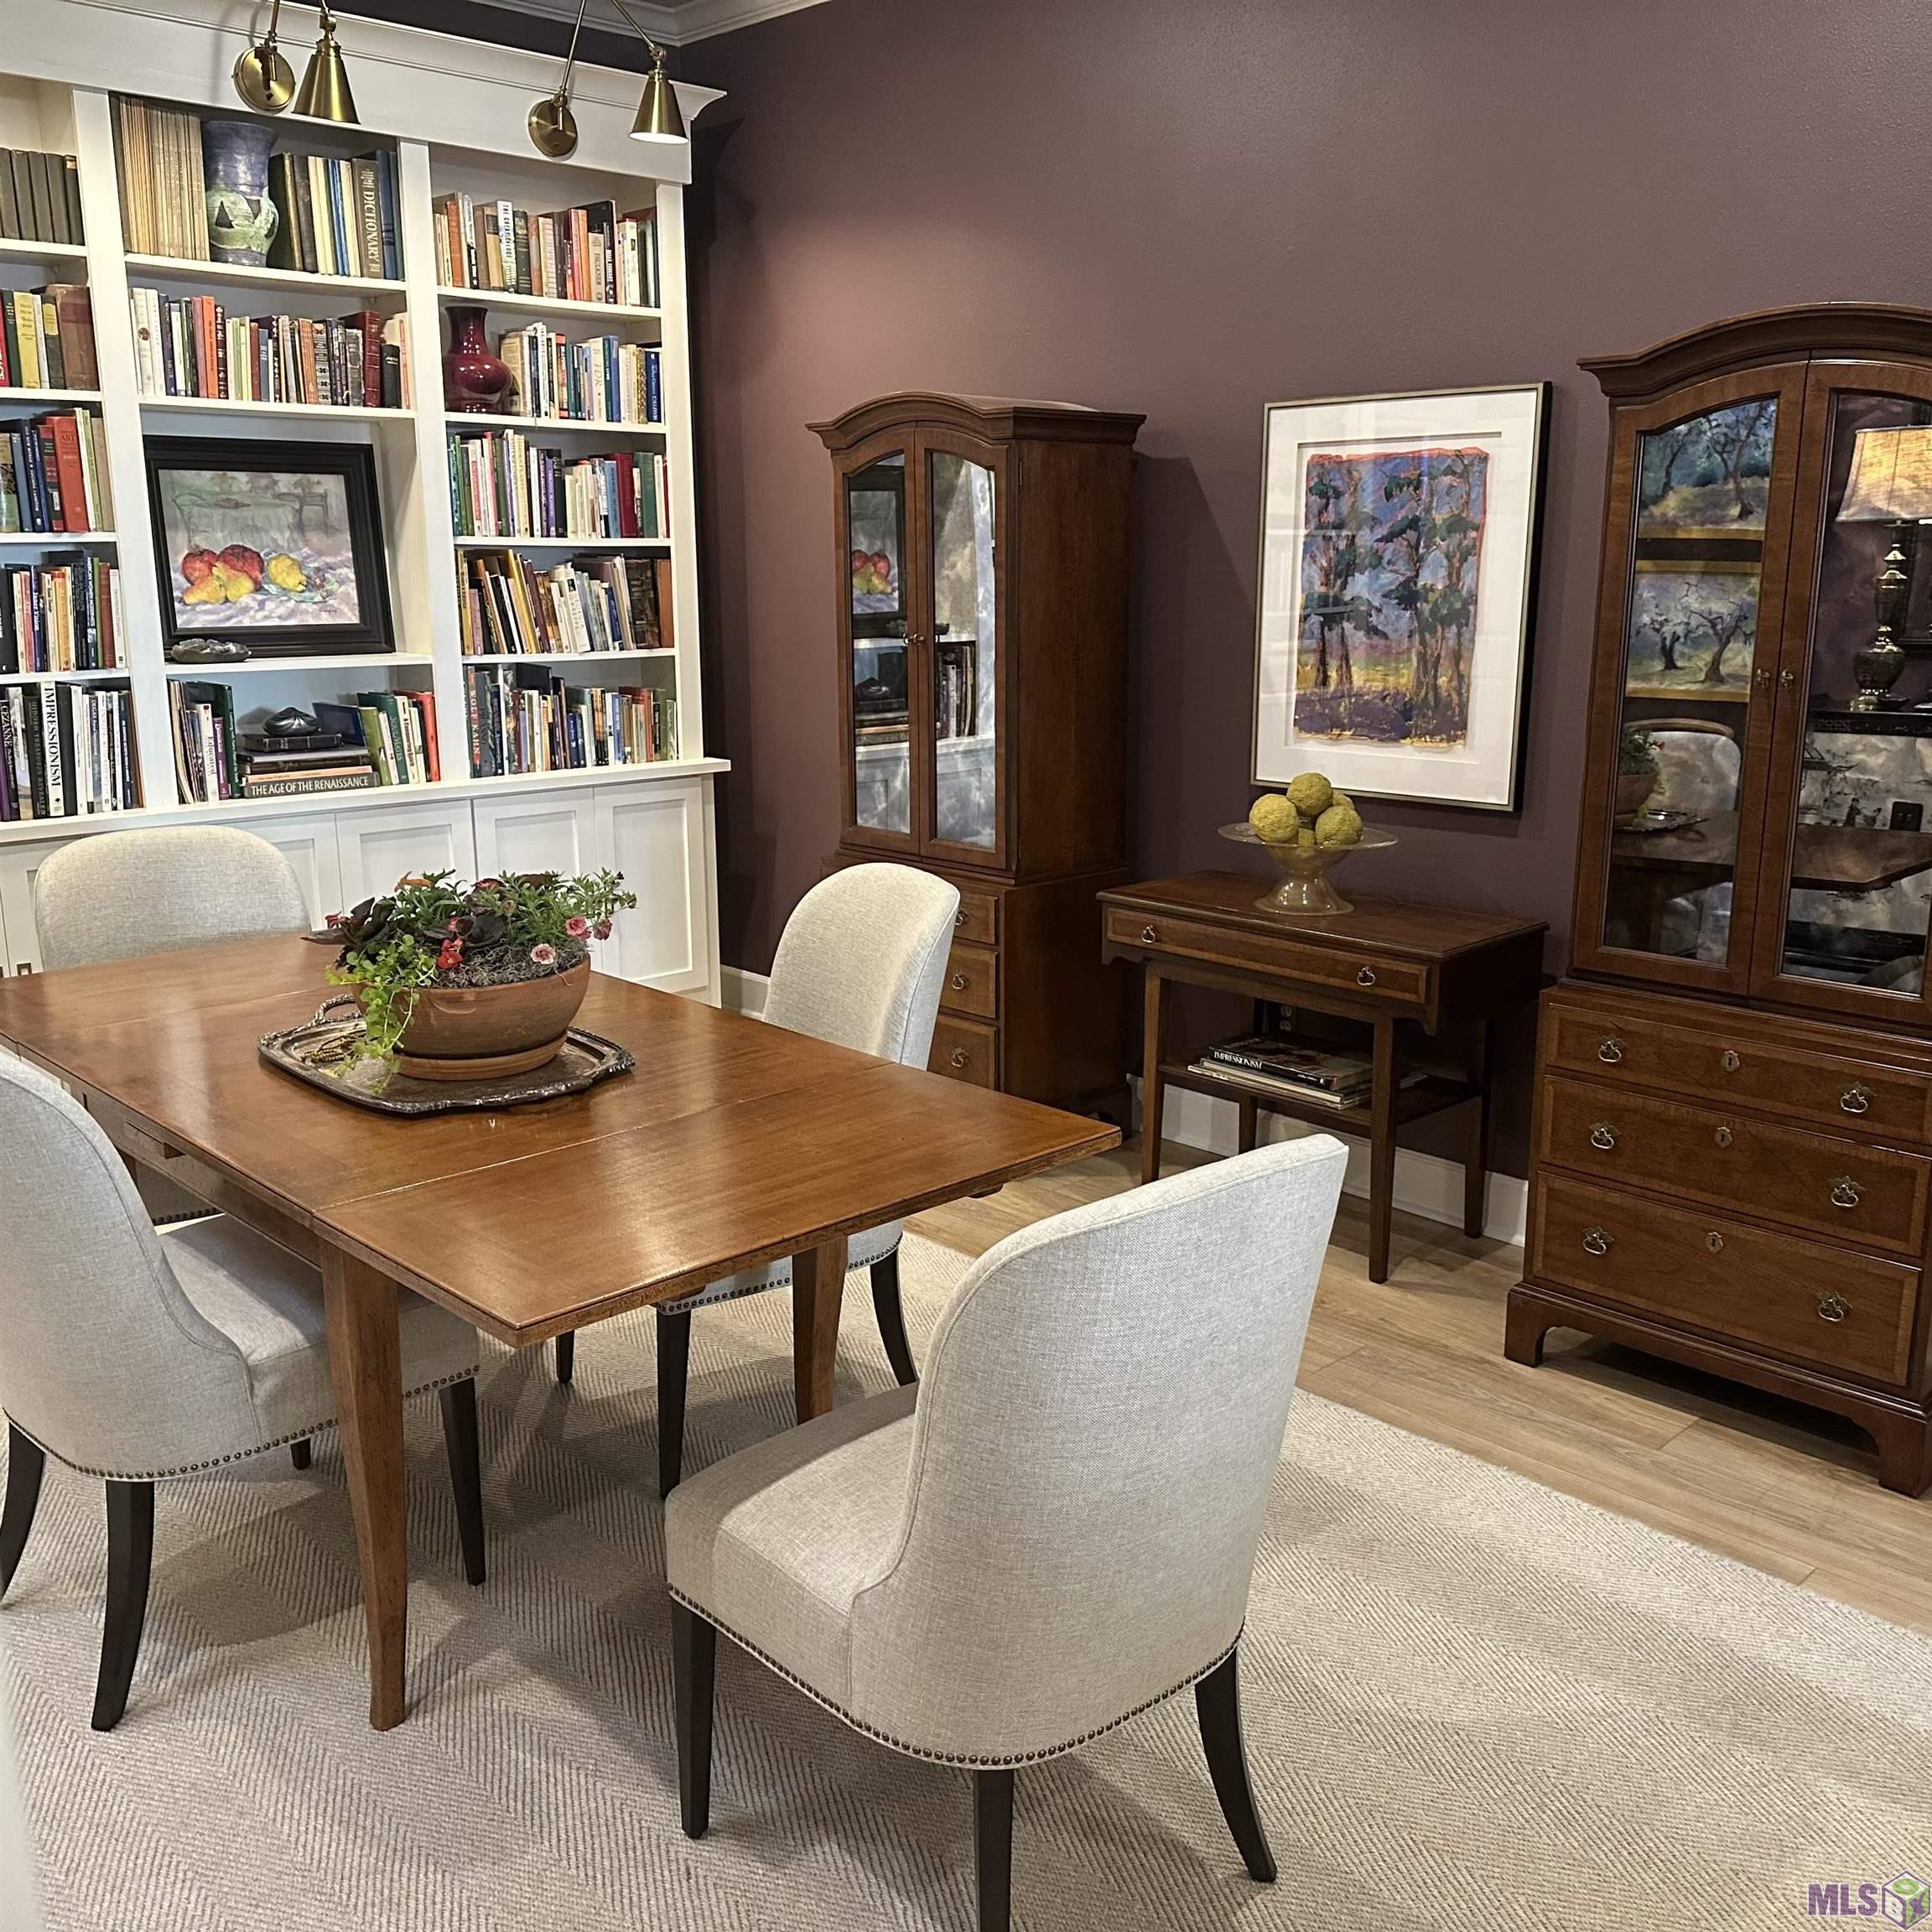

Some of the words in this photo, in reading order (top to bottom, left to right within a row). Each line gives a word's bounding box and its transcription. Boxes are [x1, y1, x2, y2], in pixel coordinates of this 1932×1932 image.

[363, 191, 379, 262] DICTIONARY
[594, 363, 602, 387] FDR
[44, 688, 60, 787] IMPRESSIONISM
[404, 723, 413, 752] Conquering
[480, 708, 488, 745] PICASSO
[34, 734, 43, 775] TREASURES
[208, 736, 216, 775] Educated
[37, 778, 46, 815] REVEALED
[252, 786, 267, 796] THE
[268, 783, 285, 793] AGE
[285, 782, 297, 792] OF
[298, 782, 314, 792] THE
[314, 776, 369, 790] RENAISSANCE
[1213, 1051, 1263, 1069] IMPRESSIONISM
